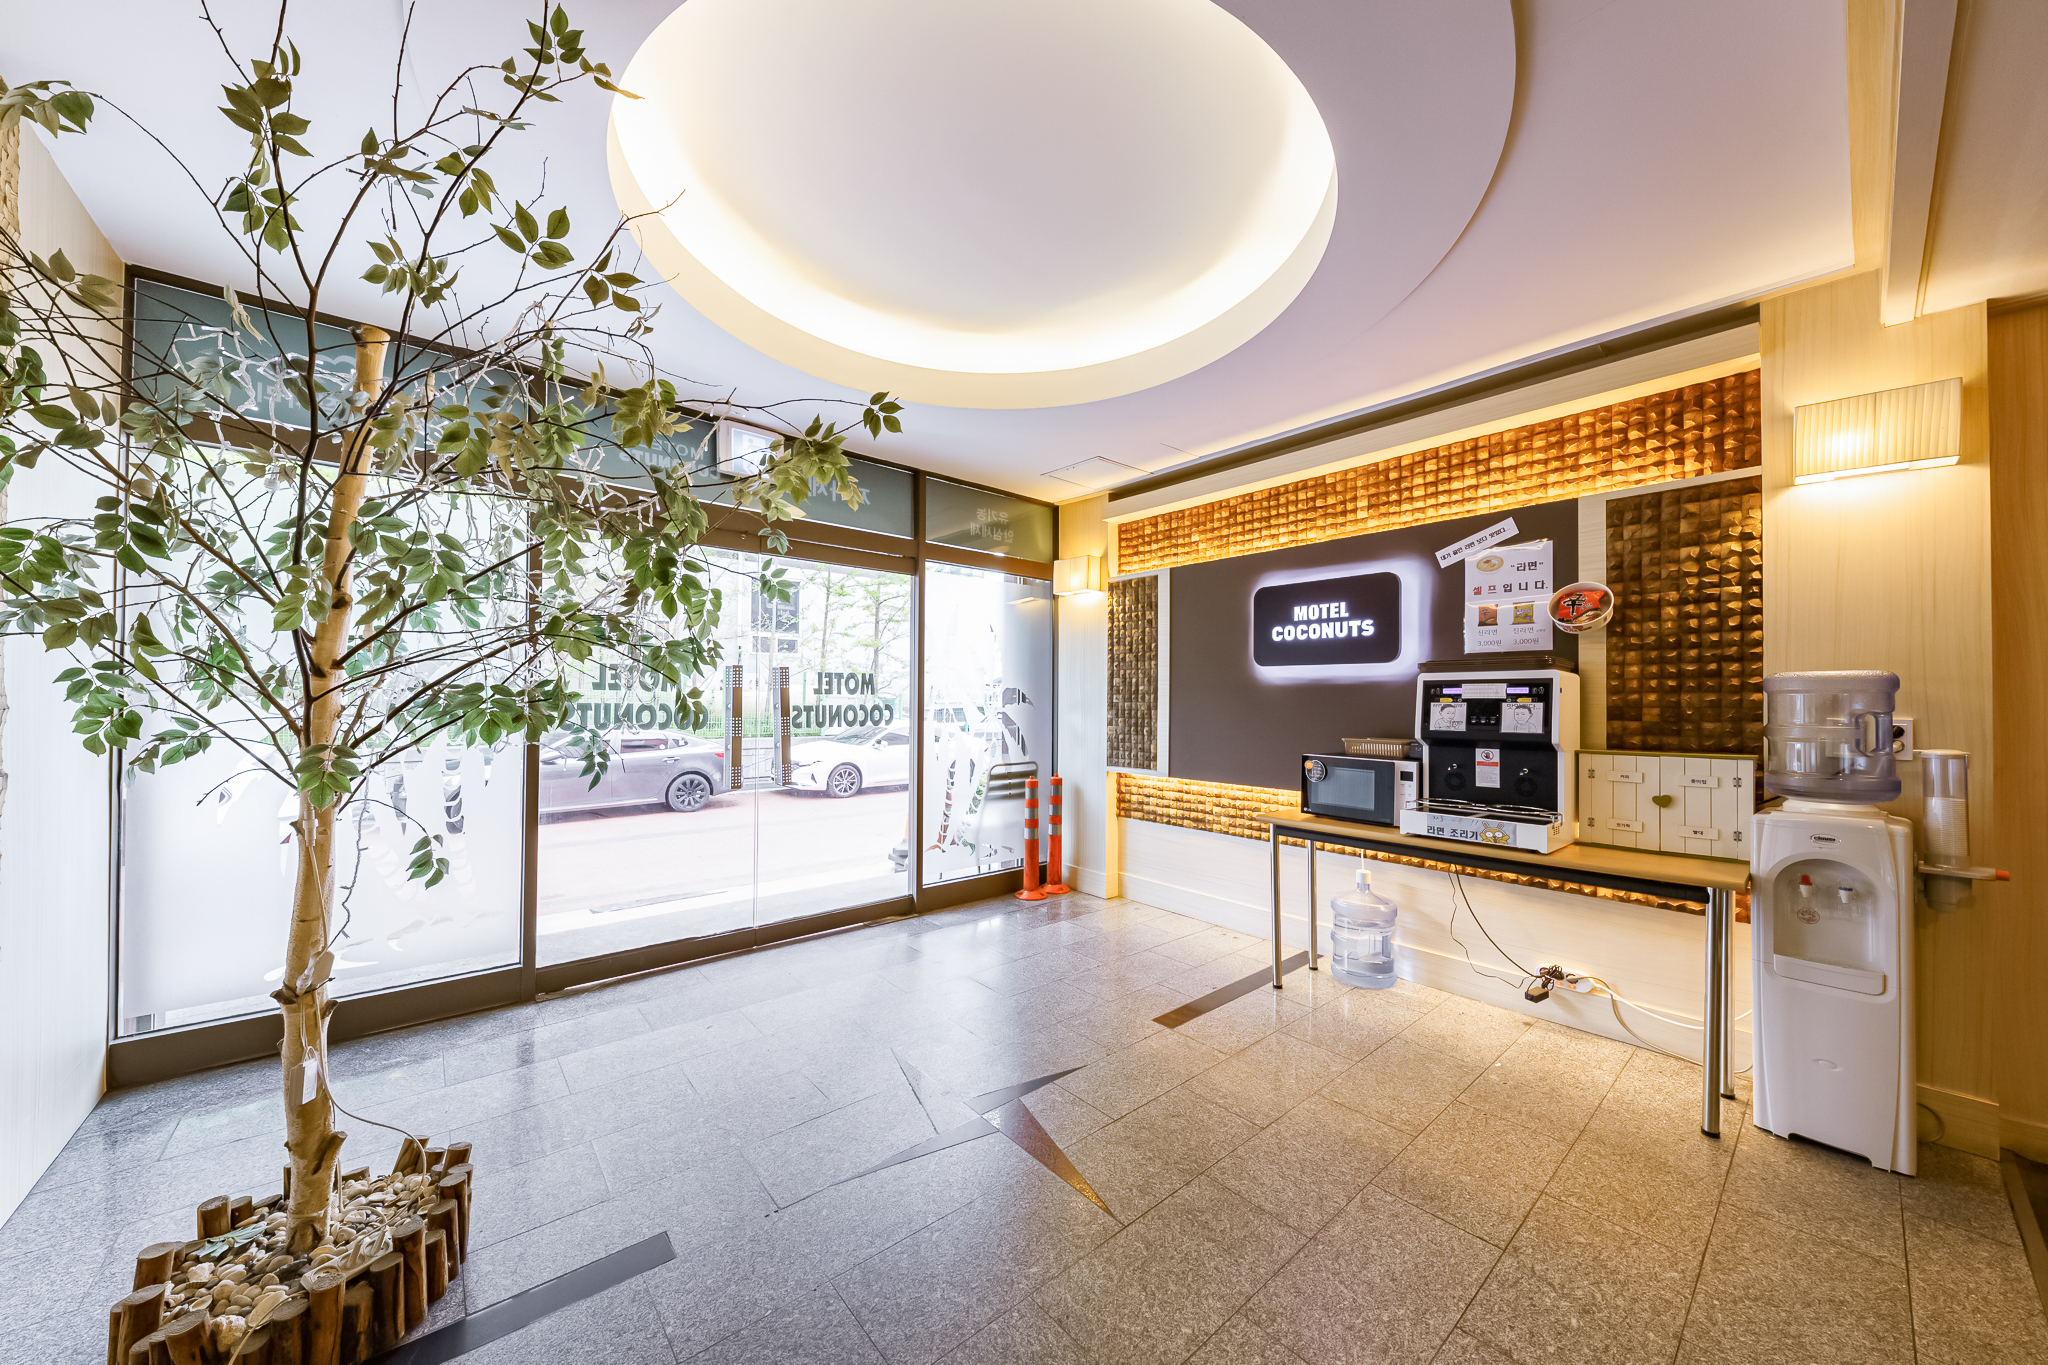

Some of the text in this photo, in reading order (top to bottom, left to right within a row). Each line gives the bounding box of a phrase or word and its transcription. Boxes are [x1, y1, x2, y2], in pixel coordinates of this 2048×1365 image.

[1464, 541, 1476, 550] 라면
[1294, 602, 1349, 622] MOTEL
[1272, 619, 1375, 642] COCONUTS
[1478, 628, 1498, 636] 신라면
[1512, 626, 1534, 634] 진라면
[1427, 826, 1478, 840] 라면 조리기
